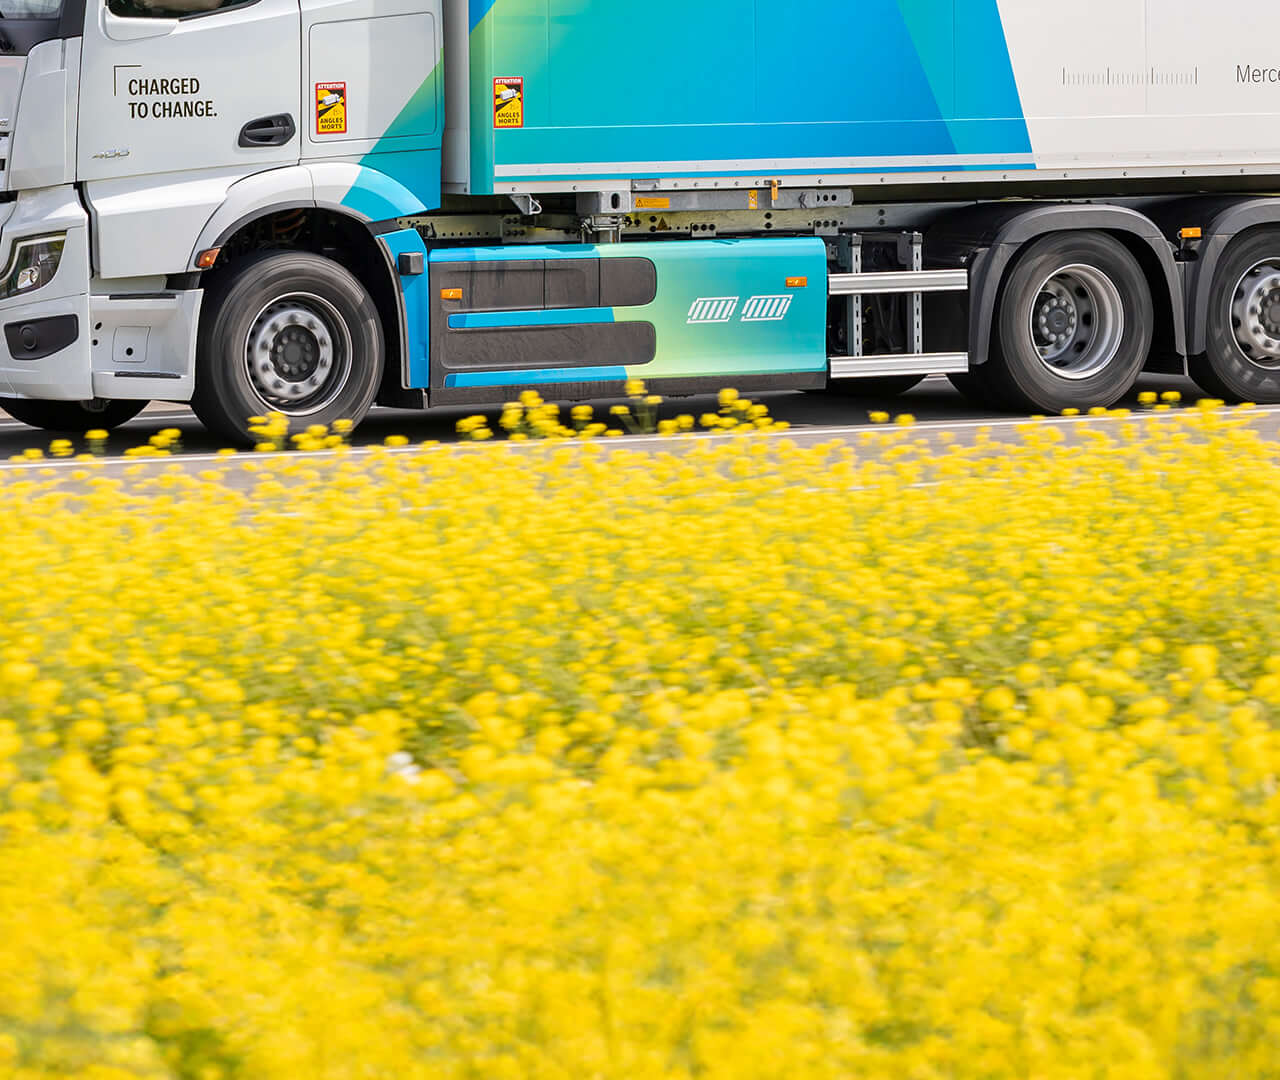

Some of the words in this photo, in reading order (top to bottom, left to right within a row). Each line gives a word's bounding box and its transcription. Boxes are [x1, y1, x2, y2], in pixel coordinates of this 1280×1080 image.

[128, 77, 200, 96] CHARGED
[127, 102, 149, 119] TO
[152, 100, 218, 119] CHANGE.
